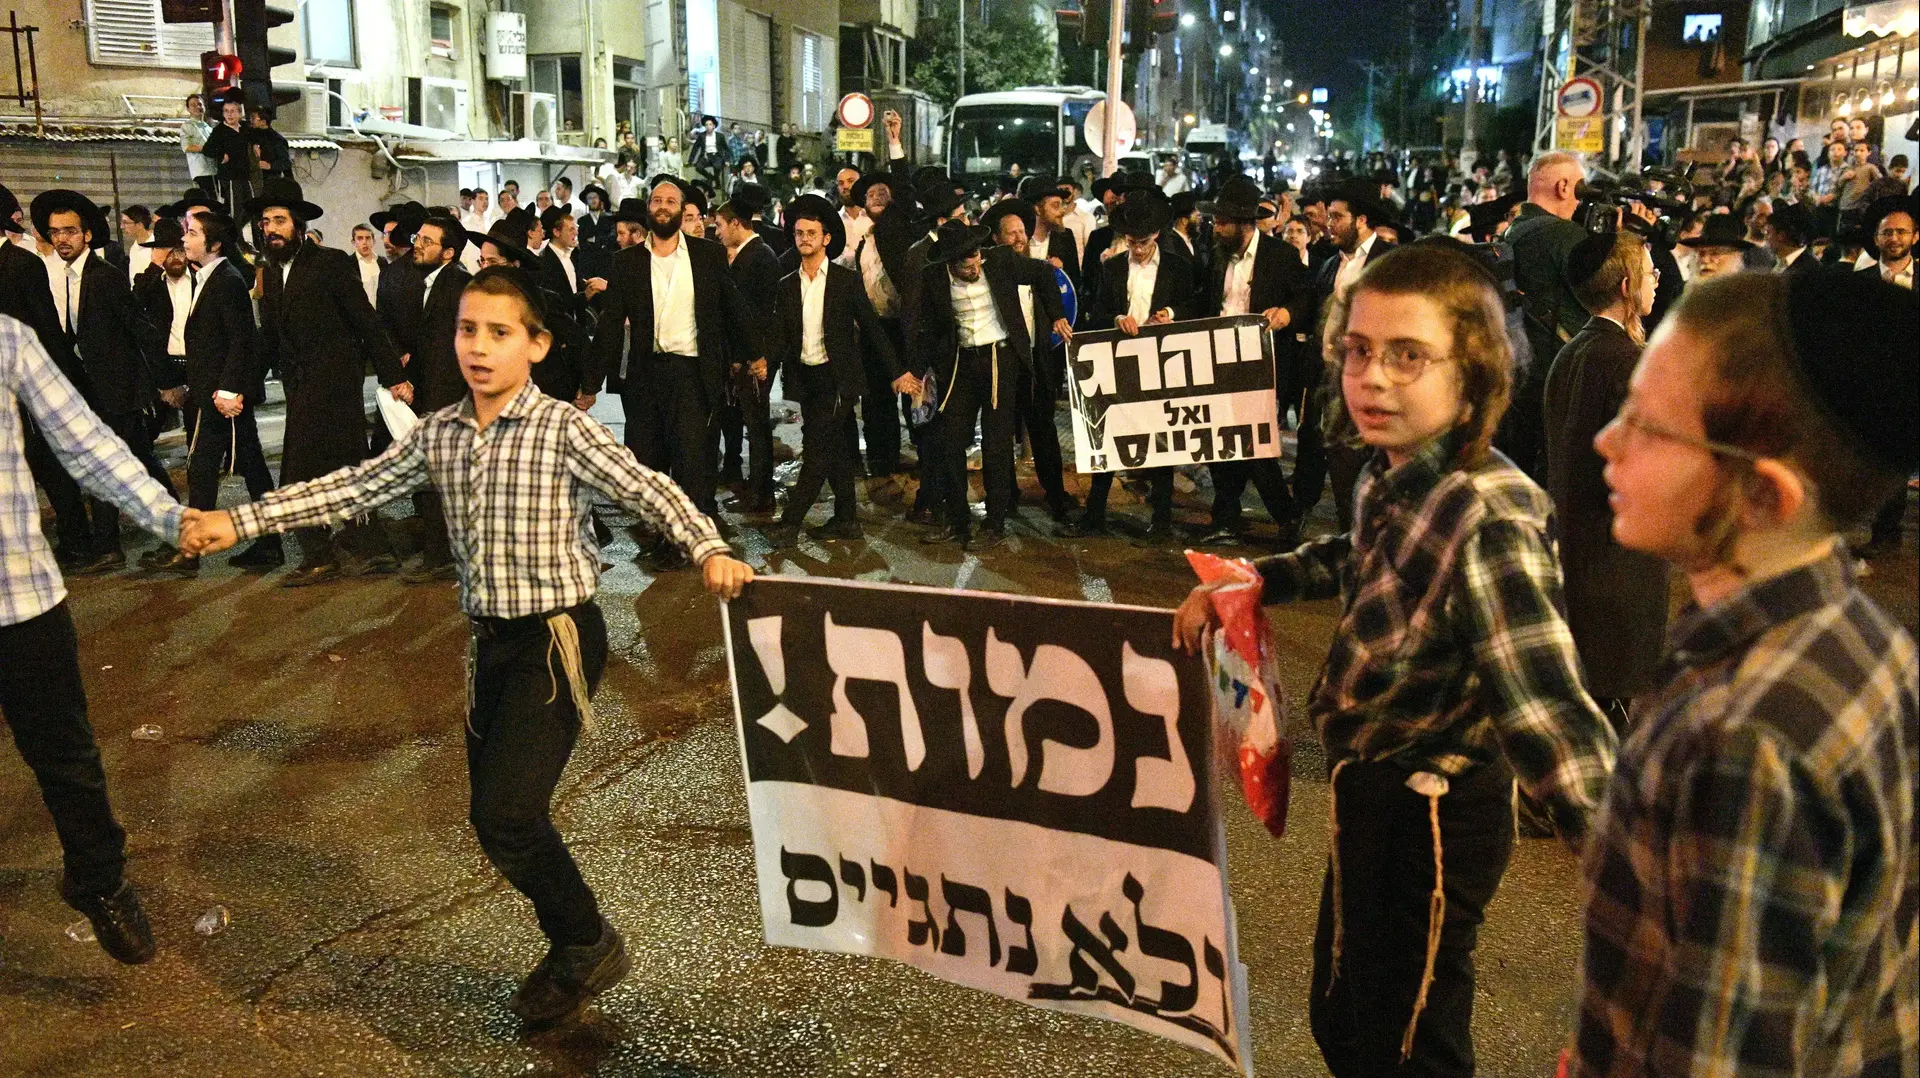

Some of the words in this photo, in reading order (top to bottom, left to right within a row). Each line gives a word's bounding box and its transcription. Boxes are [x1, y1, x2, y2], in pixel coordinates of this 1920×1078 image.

[1077, 325, 1263, 398] ייהרג
[1163, 400, 1212, 426] ואל
[747, 610, 1197, 814] נמות!
[1061, 871, 1231, 1036] ולא
